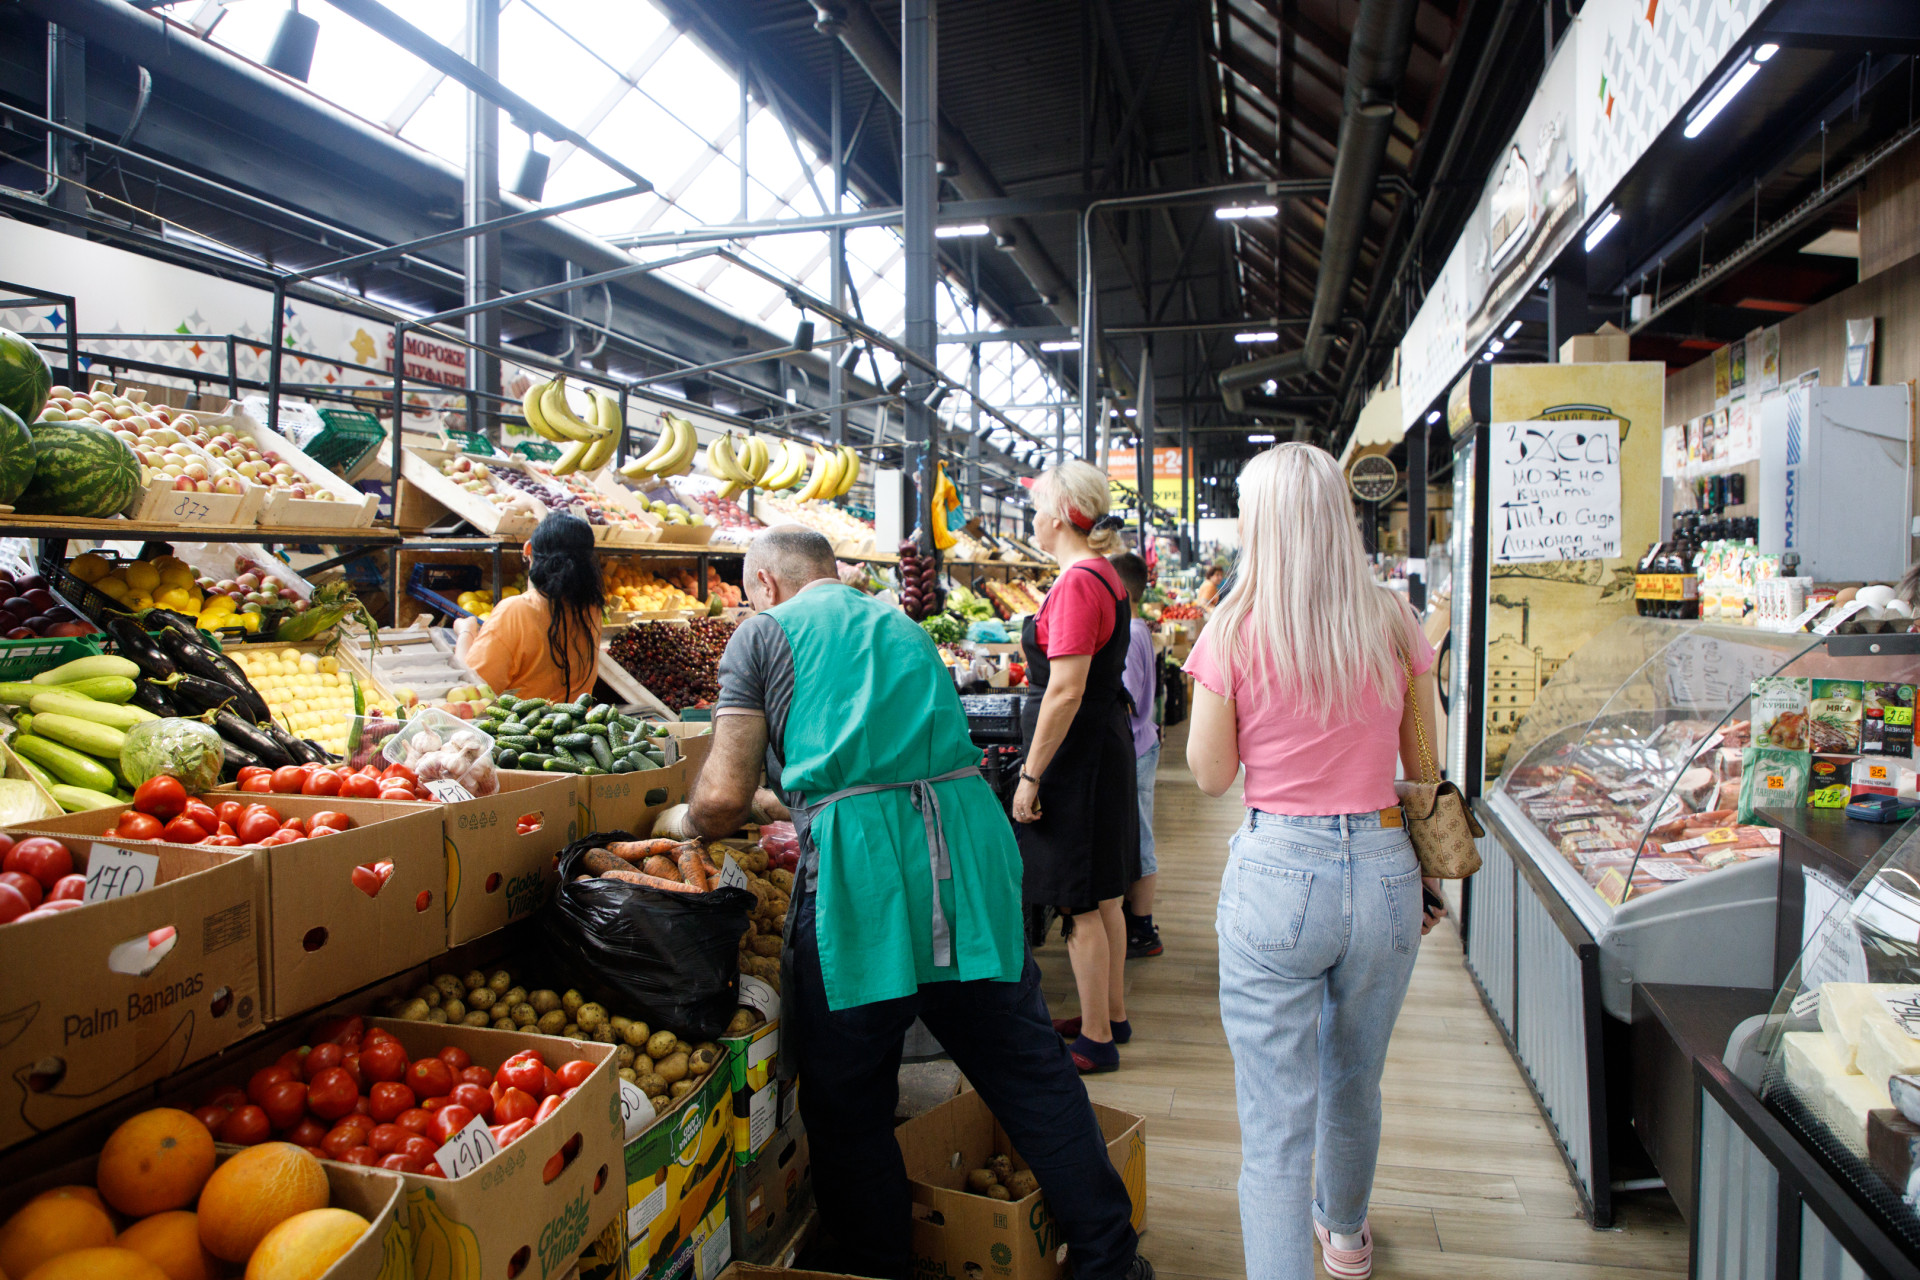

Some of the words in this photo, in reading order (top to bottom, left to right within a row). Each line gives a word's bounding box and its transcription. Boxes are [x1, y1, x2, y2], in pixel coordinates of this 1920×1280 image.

[174, 496, 210, 520] 877
[1762, 702, 1799, 710] КУРИЦЫ
[1826, 704, 1852, 712] МЯСА
[1885, 724, 1912, 733] Базилик
[1892, 744, 1900, 752] 10
[87, 865, 144, 900] 170
[505, 866, 546, 899] Global
[64, 1008, 119, 1046] Palm
[128, 972, 204, 1022] Bananas
[679, 1117, 701, 1151] BANANA
[683, 1113, 699, 1137] LAND
[538, 1184, 591, 1257] Global
[540, 1214, 590, 1280] Village
